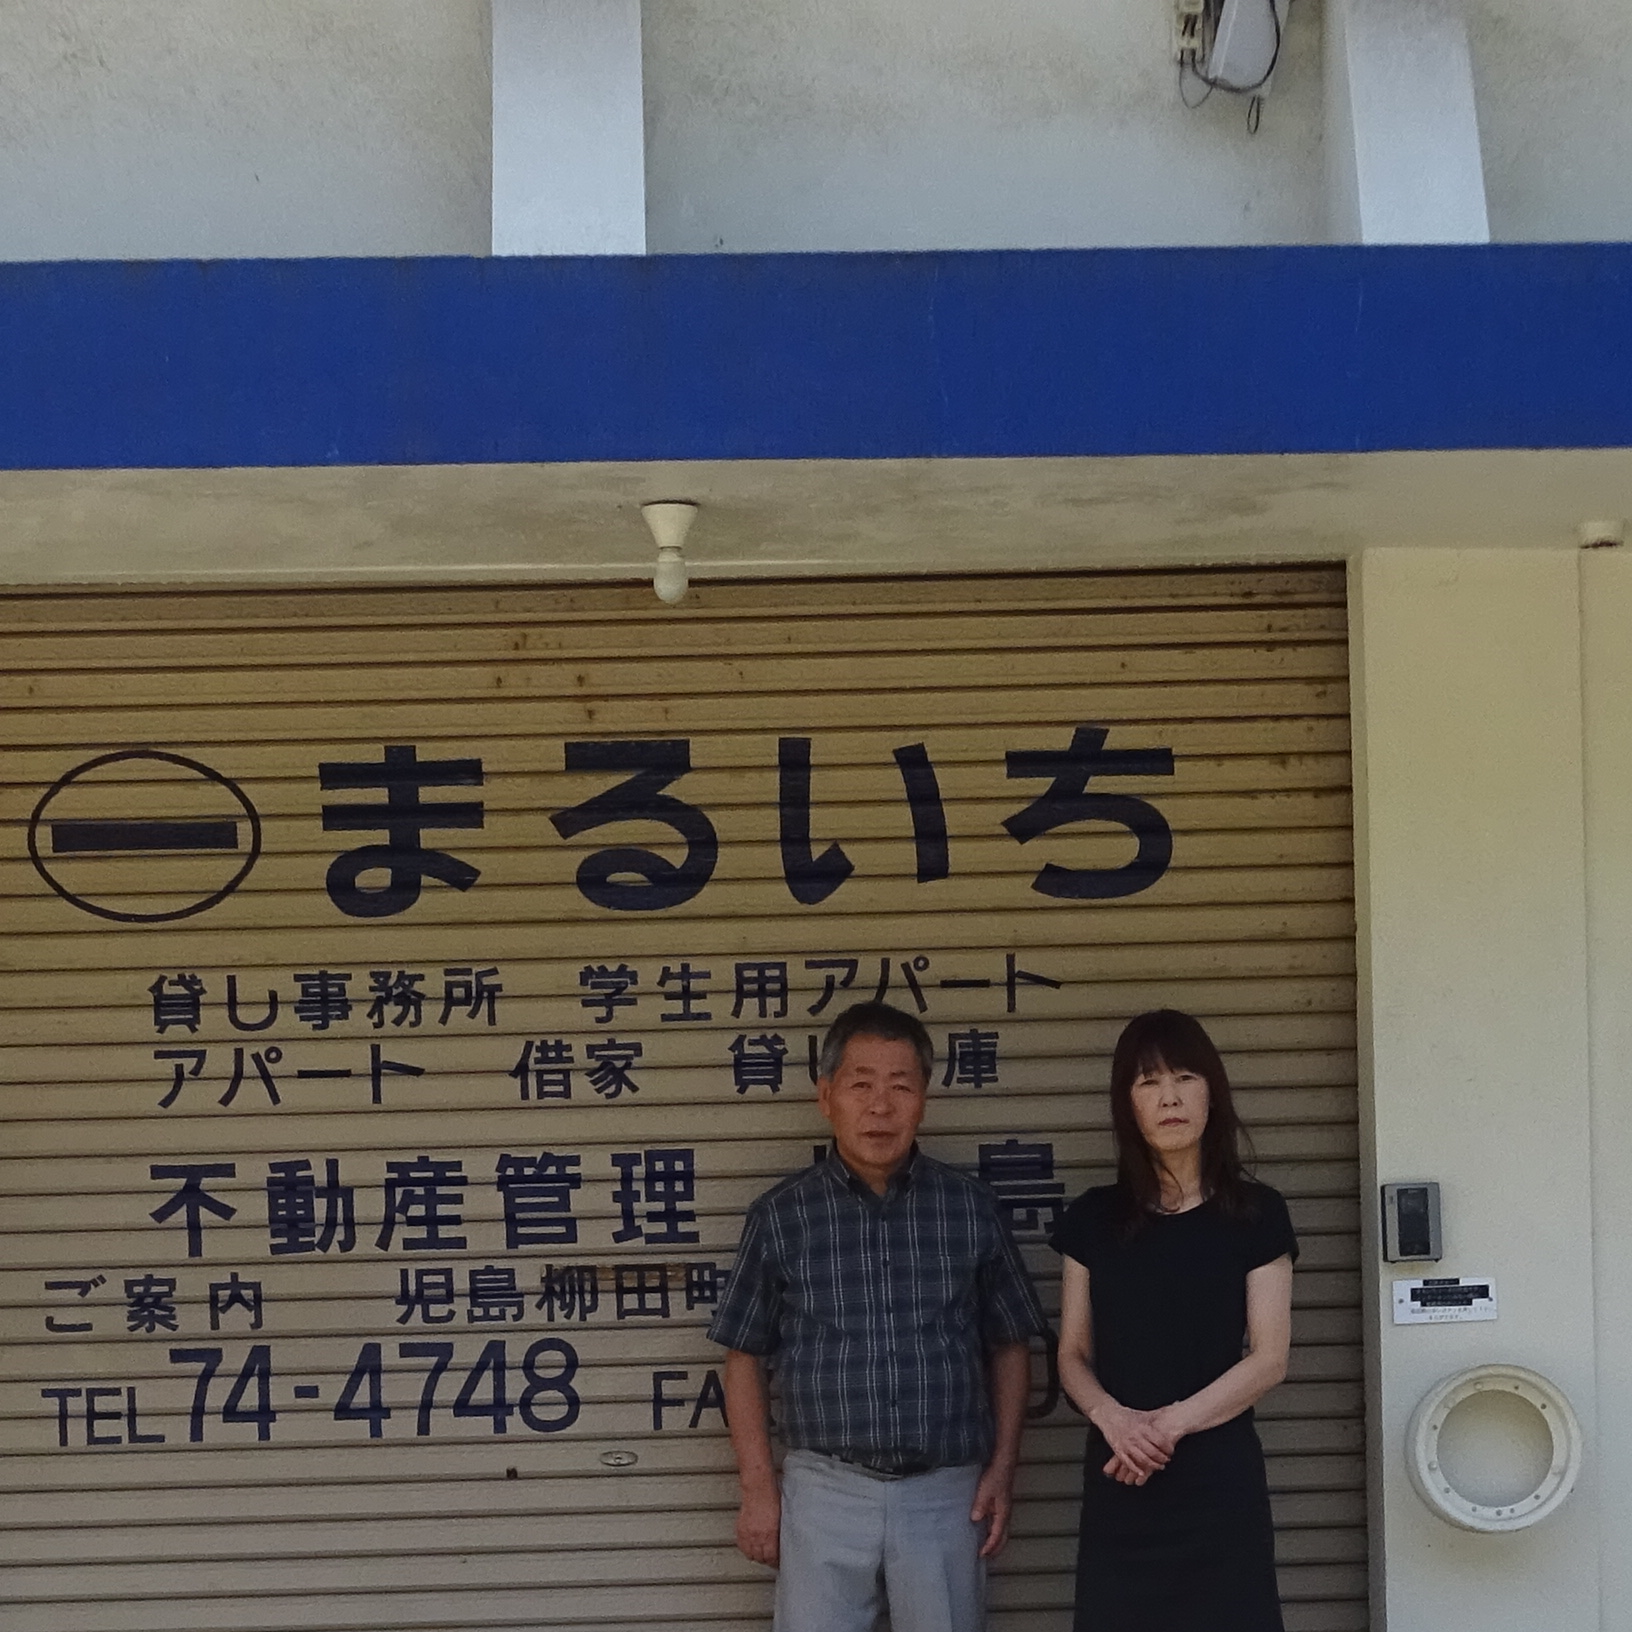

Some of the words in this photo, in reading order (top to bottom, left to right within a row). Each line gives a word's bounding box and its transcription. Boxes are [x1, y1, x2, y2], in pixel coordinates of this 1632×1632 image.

[318, 727, 1175, 917] まるいち
[148, 966, 504, 1034] 貸し事務所
[578, 953, 1062, 1024] 学生用アパート
[153, 1043, 425, 1108] アパート
[509, 1039, 644, 1100] 借家
[149, 1148, 701, 1258] 不動産管理
[44, 1272, 264, 1332] ご案内
[652, 1369, 780, 1430] FA
